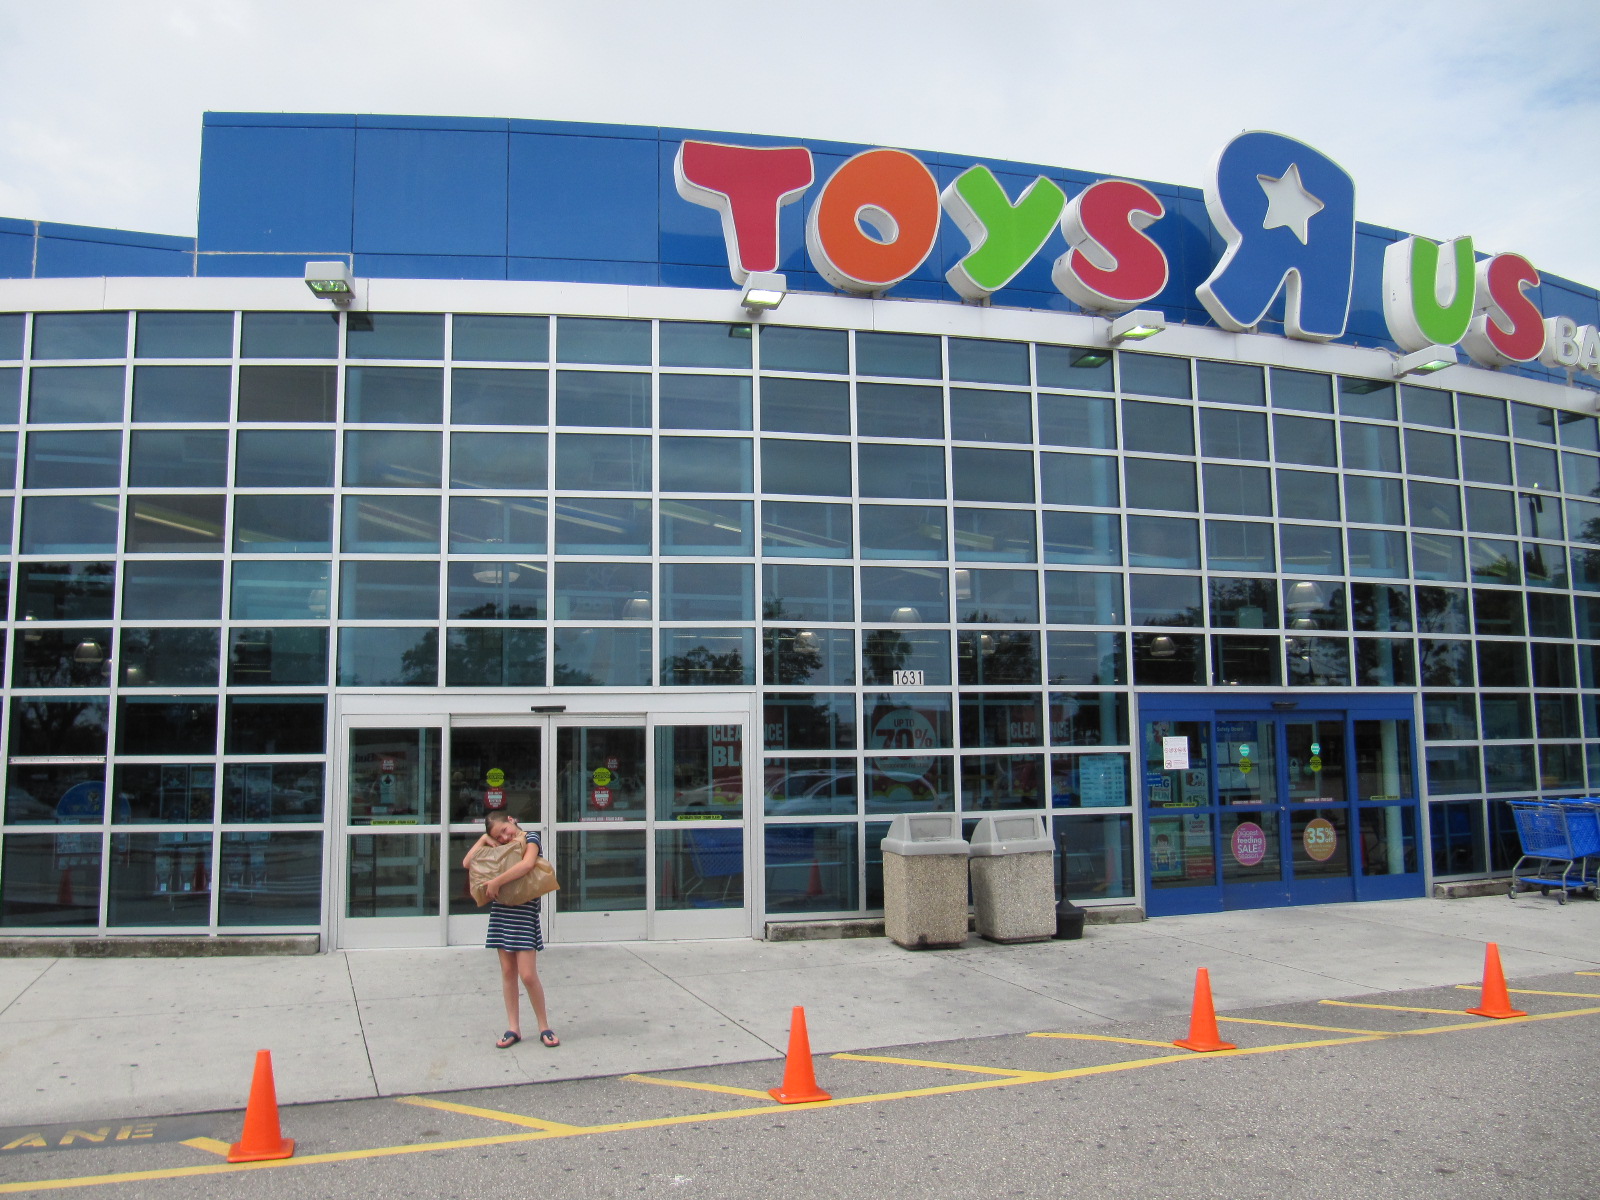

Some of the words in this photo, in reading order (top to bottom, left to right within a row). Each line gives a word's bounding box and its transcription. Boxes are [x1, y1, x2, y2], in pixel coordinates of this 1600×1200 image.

[676, 139, 1169, 310] TOYS
[1384, 235, 1545, 366] US
[895, 671, 922, 685] 1631
[893, 718, 904, 728] UP
[906, 718, 915, 728] TO
[876, 728, 933, 760] 70%
[1237, 836, 1263, 846] feeding
[1307, 827, 1334, 843] 35%
[1237, 844, 1258, 854] SALE
